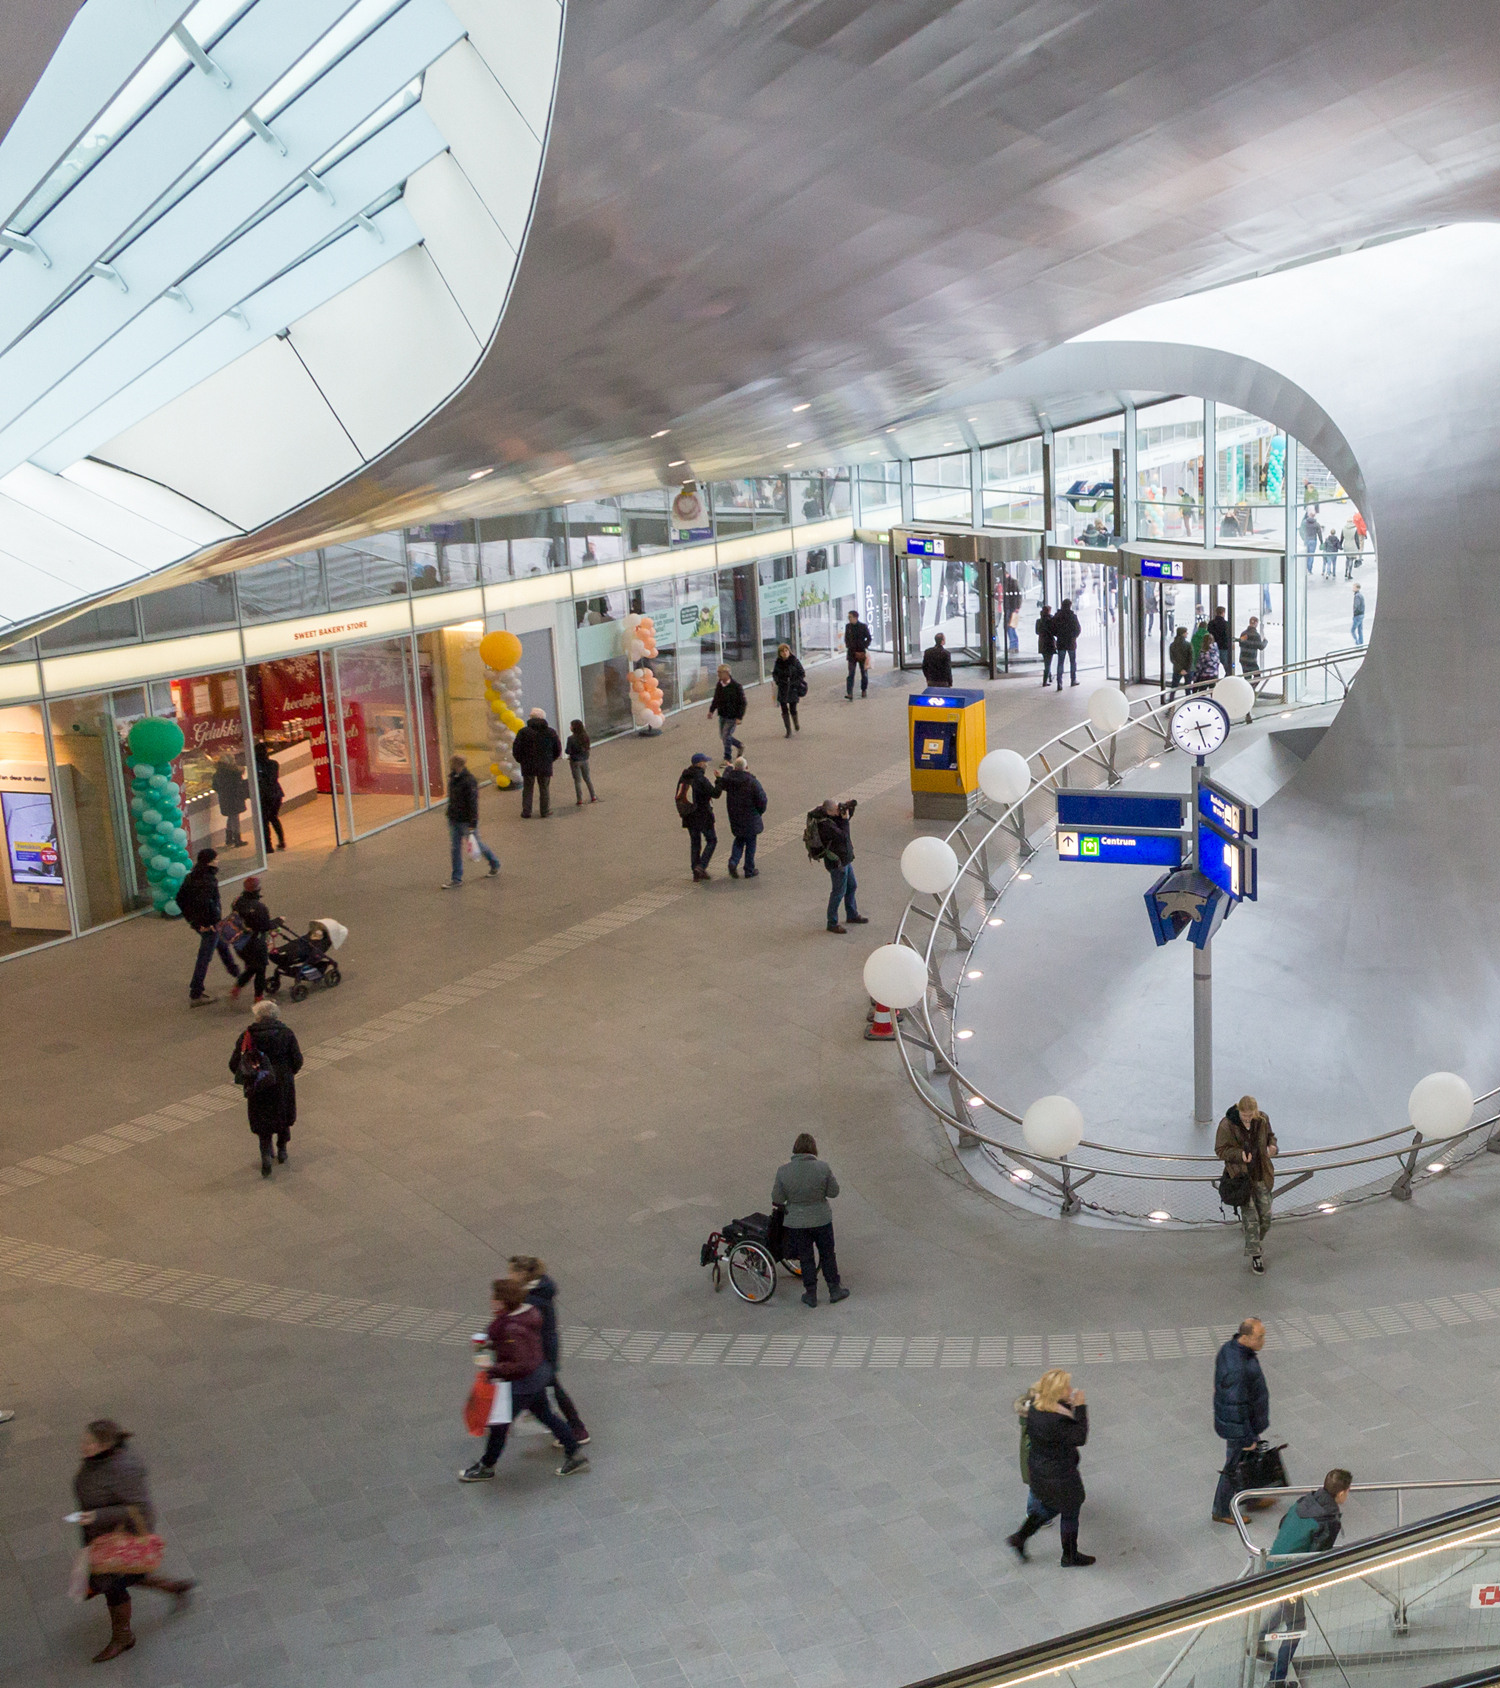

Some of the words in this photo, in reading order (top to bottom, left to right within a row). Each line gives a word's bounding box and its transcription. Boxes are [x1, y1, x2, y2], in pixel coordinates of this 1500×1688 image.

[294, 630, 317, 640] SWEET
[318, 625, 345, 636] BAKERY
[346, 621, 368, 631] STORE
[1101, 837, 1136, 846] Centrum
